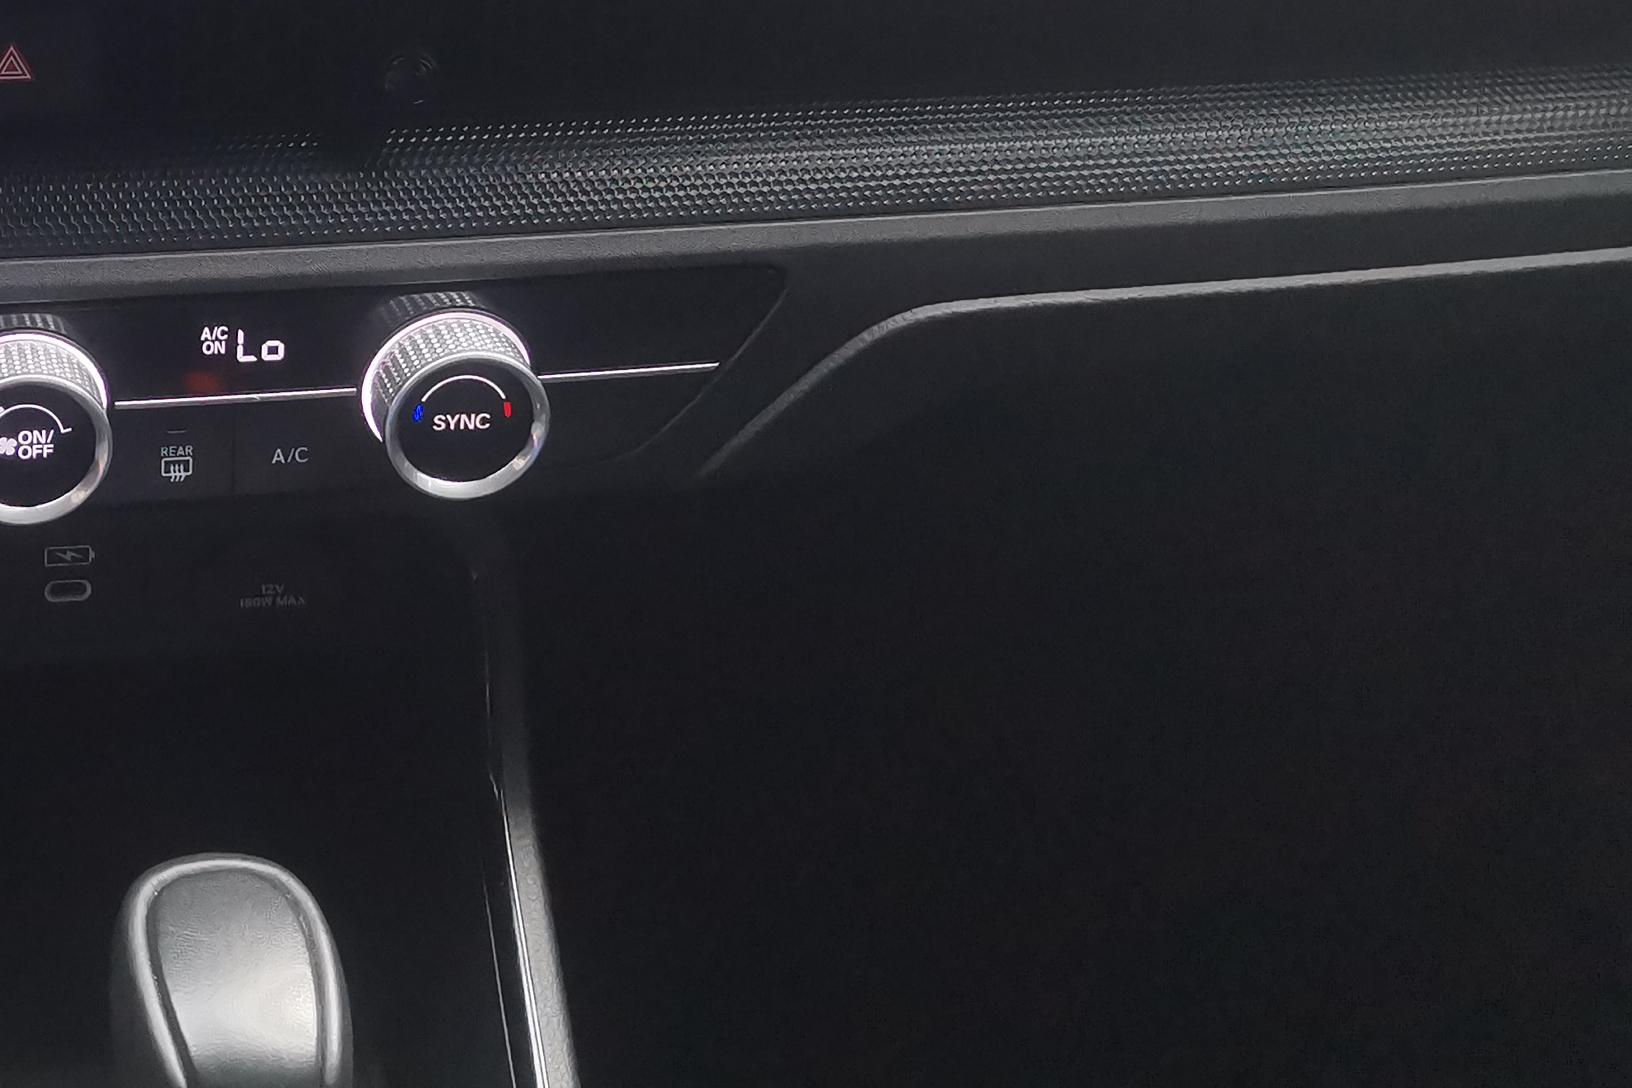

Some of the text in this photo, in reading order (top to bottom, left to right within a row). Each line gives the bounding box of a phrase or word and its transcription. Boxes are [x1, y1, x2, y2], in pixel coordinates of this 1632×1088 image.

[200, 325, 229, 340] A/C
[201, 339, 228, 355] ON
[236, 328, 285, 363] Lo
[432, 412, 491, 431] SYNC
[17, 429, 55, 445] ON/
[17, 443, 55, 460] OFF
[160, 444, 194, 457] REAR
[271, 447, 309, 465] A/C
